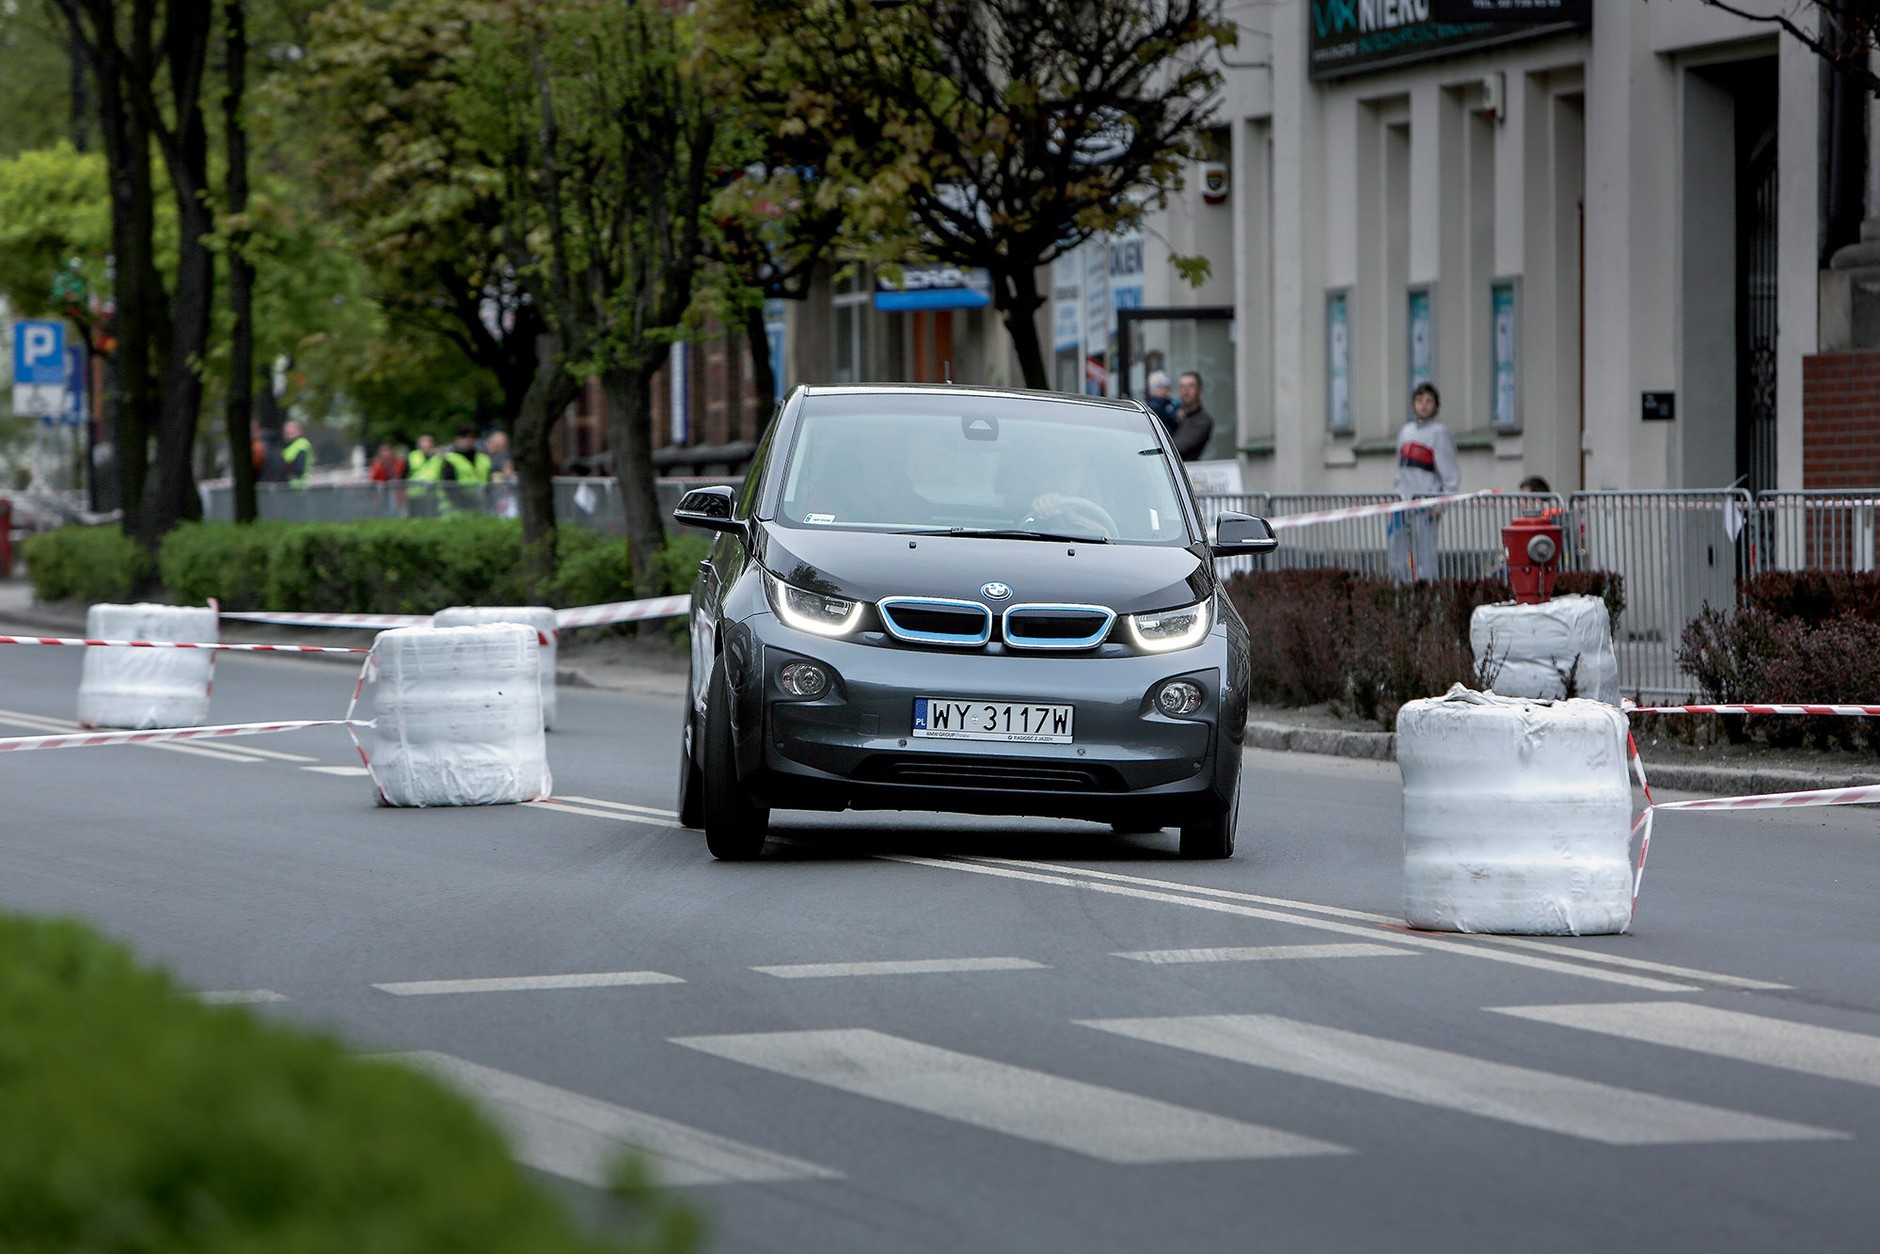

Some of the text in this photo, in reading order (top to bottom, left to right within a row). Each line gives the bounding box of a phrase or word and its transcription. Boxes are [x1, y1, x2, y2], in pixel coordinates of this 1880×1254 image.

[24, 328, 55, 367] P
[915, 718, 926, 726] PL
[933, 702, 1069, 734] WY 3117W
